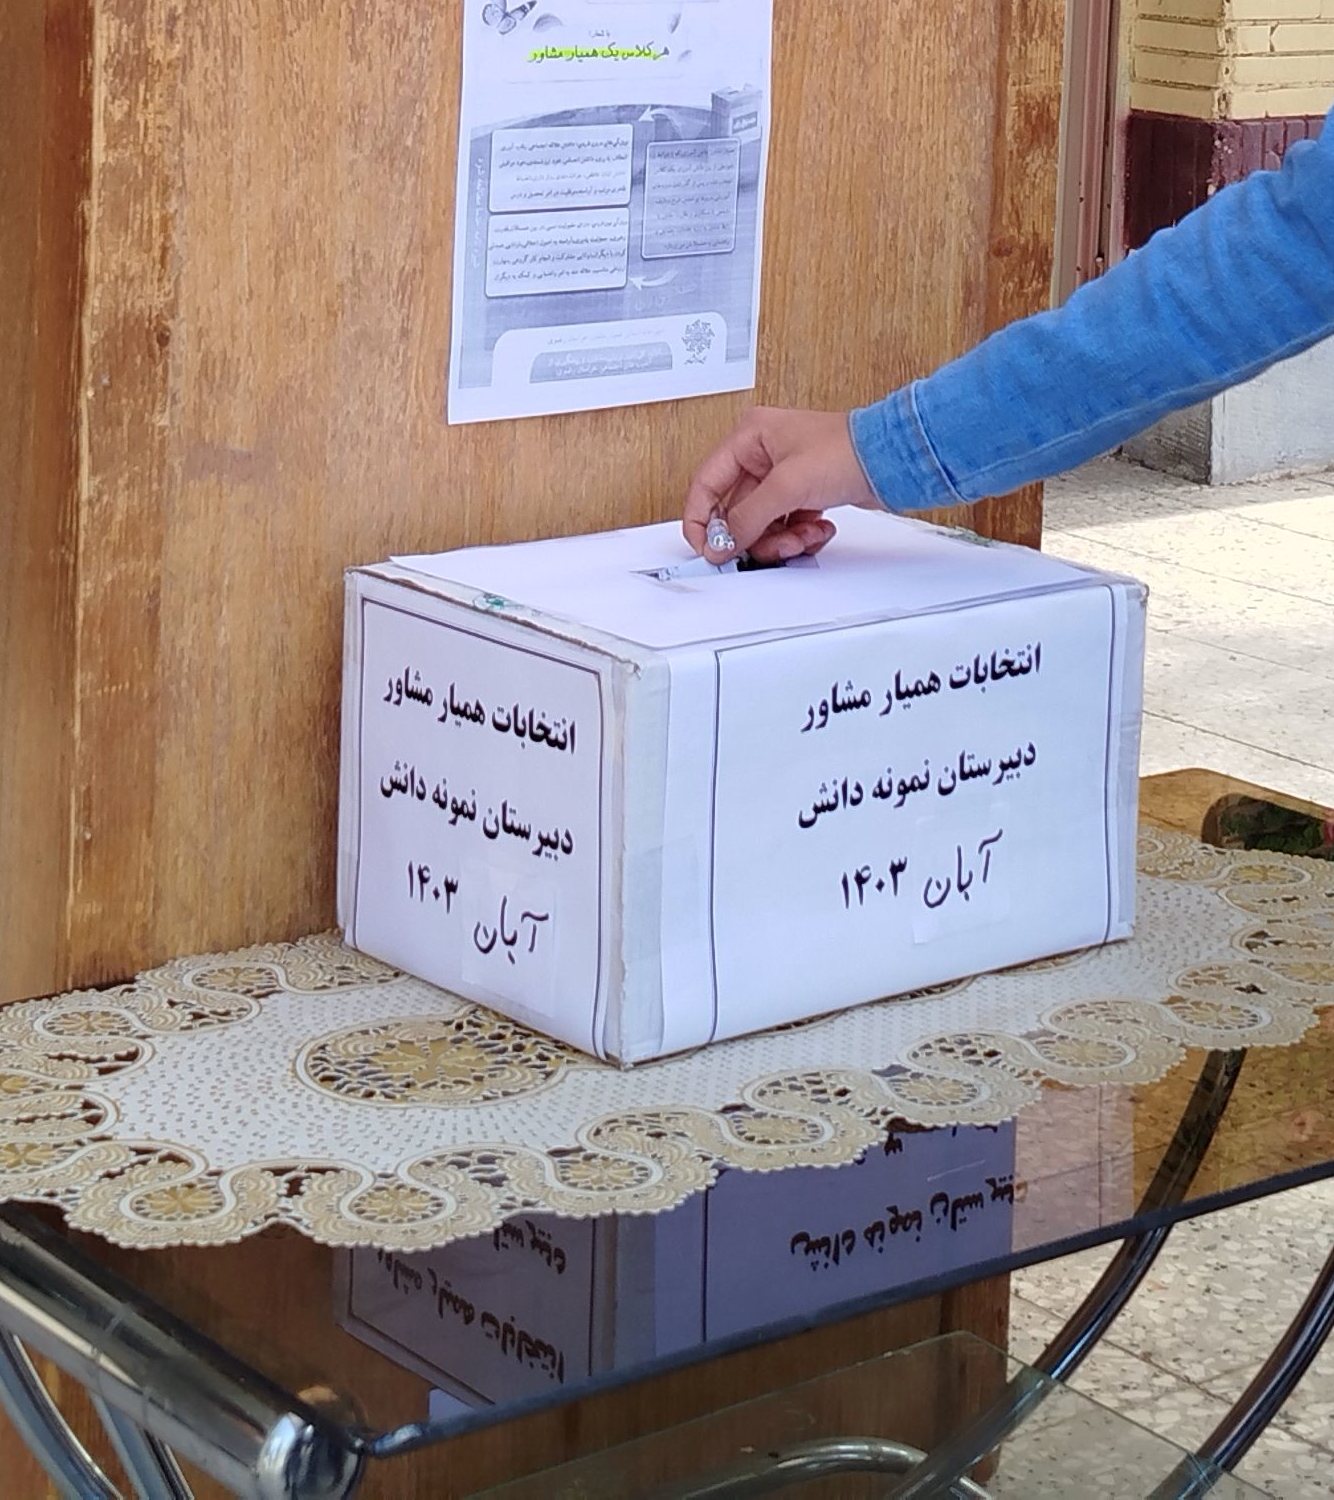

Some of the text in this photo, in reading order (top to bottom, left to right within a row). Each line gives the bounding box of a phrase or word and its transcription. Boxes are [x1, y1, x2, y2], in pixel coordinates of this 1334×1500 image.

[527, 40, 670, 64] هر کلاس یک همیار مشاور
[382, 666, 576, 754] انتخابات همیار مشاور
[800, 641, 1041, 733] انتخابات همیار مشاور
[380, 760, 574, 862] دبیرستان نمونه دانش
[798, 741, 1037, 829] دبیرستان نمونه دانش
[407, 859, 549, 965] آبان ۱۴۰۳
[841, 828, 1003, 910] آبان ۱۴۰۳
